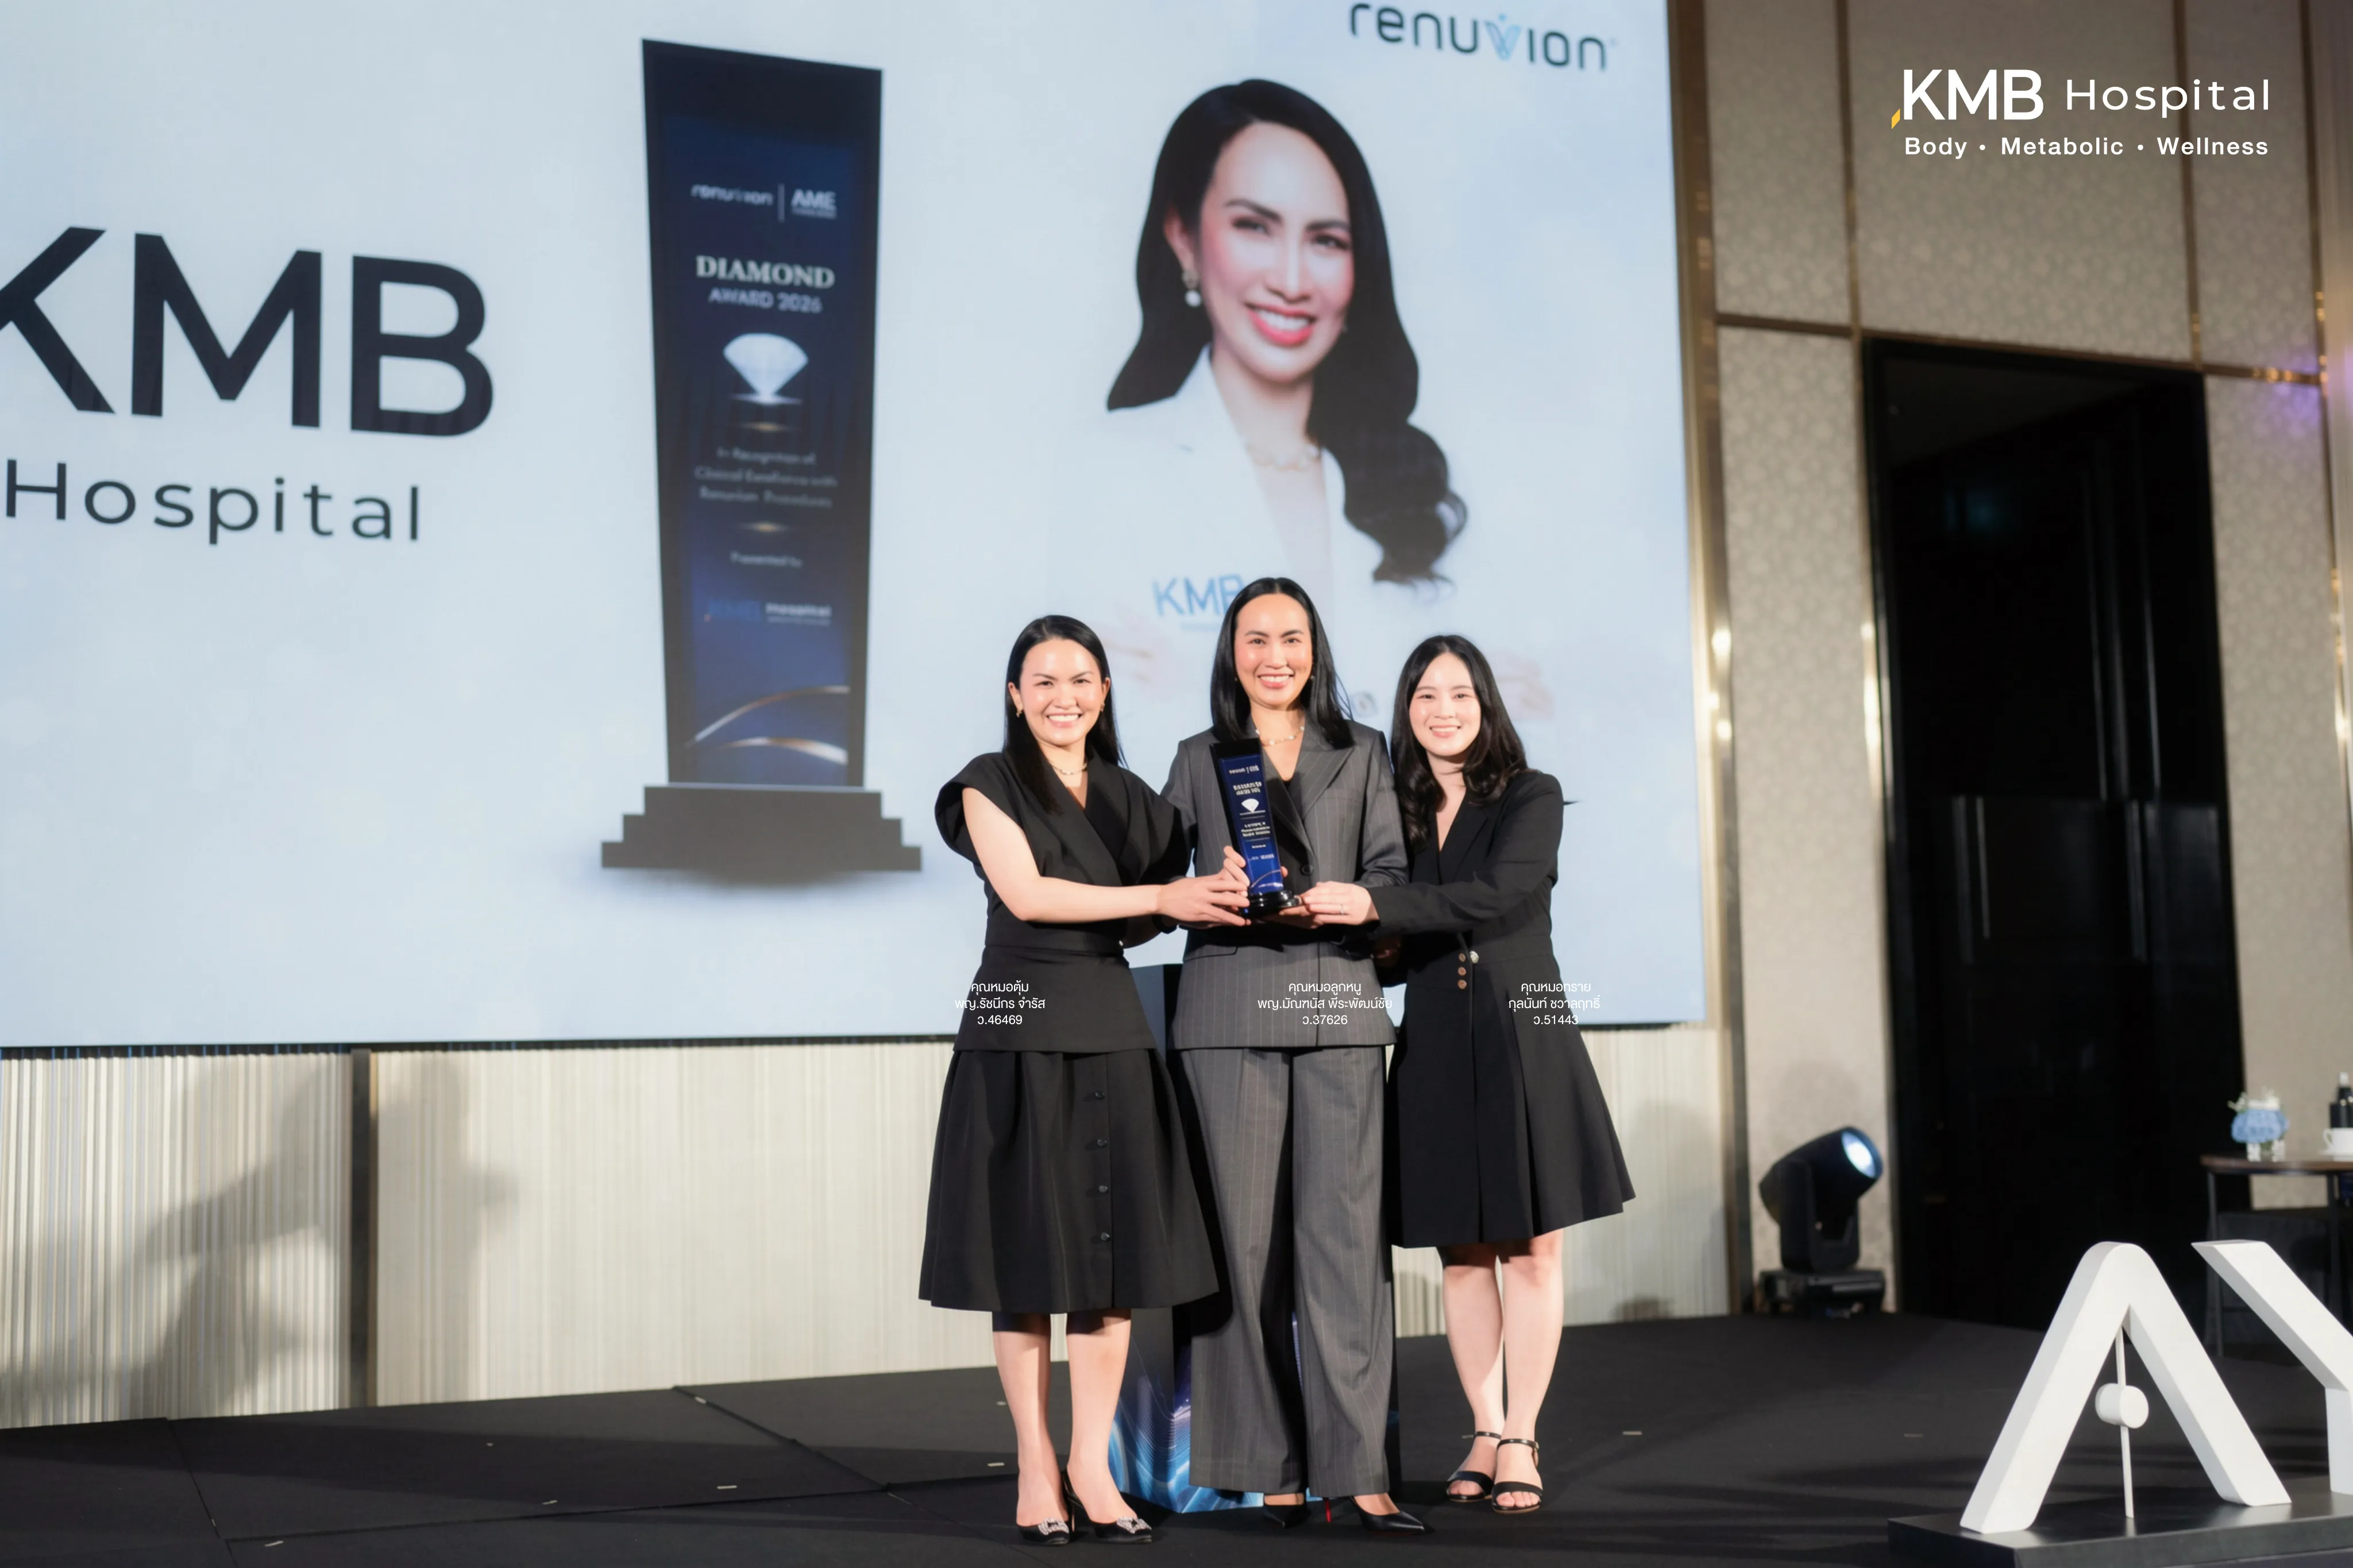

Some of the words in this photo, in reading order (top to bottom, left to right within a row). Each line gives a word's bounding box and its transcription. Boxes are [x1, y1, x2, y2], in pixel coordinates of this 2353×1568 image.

[1350, 3, 1607, 70] renuvion
[791, 188, 836, 211] AME
[696, 255, 836, 289] DIAMOND
[708, 287, 774, 309] AWARD
[0, 226, 494, 438] KMB
[5, 459, 420, 546] Hospital
